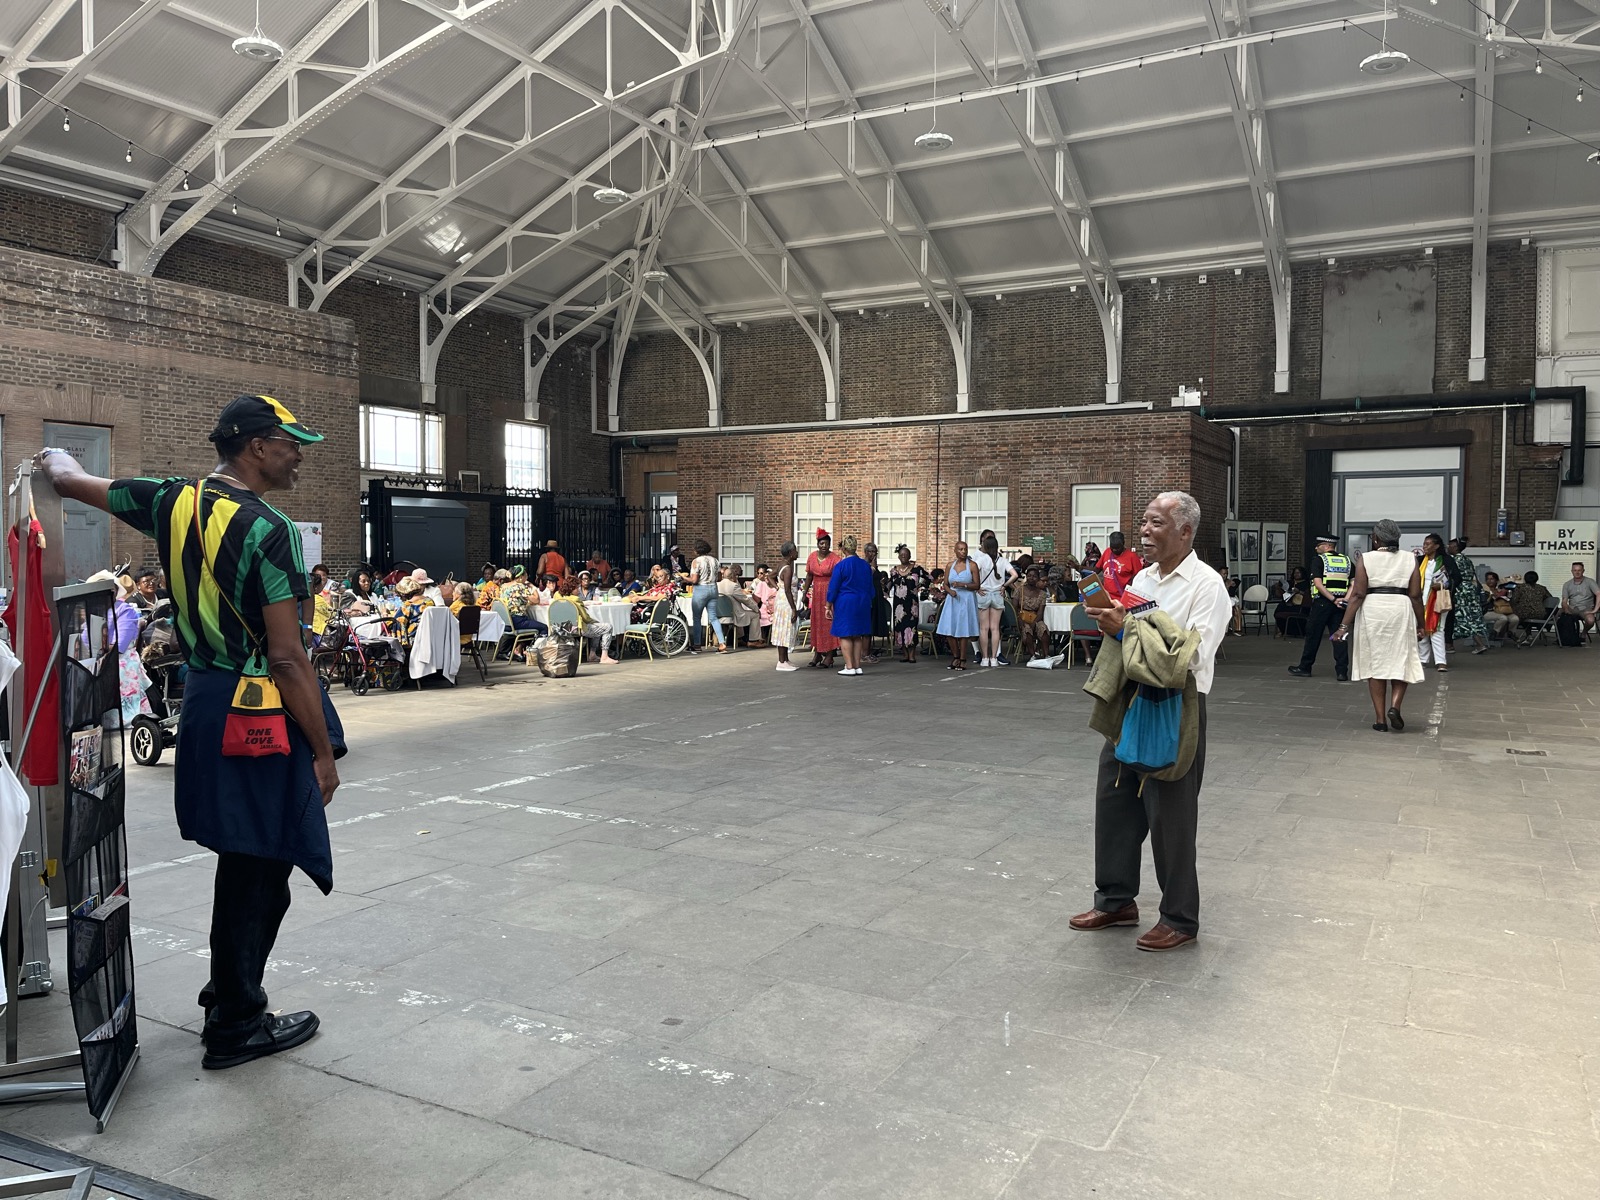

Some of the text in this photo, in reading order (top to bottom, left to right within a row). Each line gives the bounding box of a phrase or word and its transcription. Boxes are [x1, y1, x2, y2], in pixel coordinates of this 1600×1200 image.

[1558, 528, 1576, 538] BY
[1538, 541, 1595, 551] THAMES
[247, 728, 272, 736] ONE
